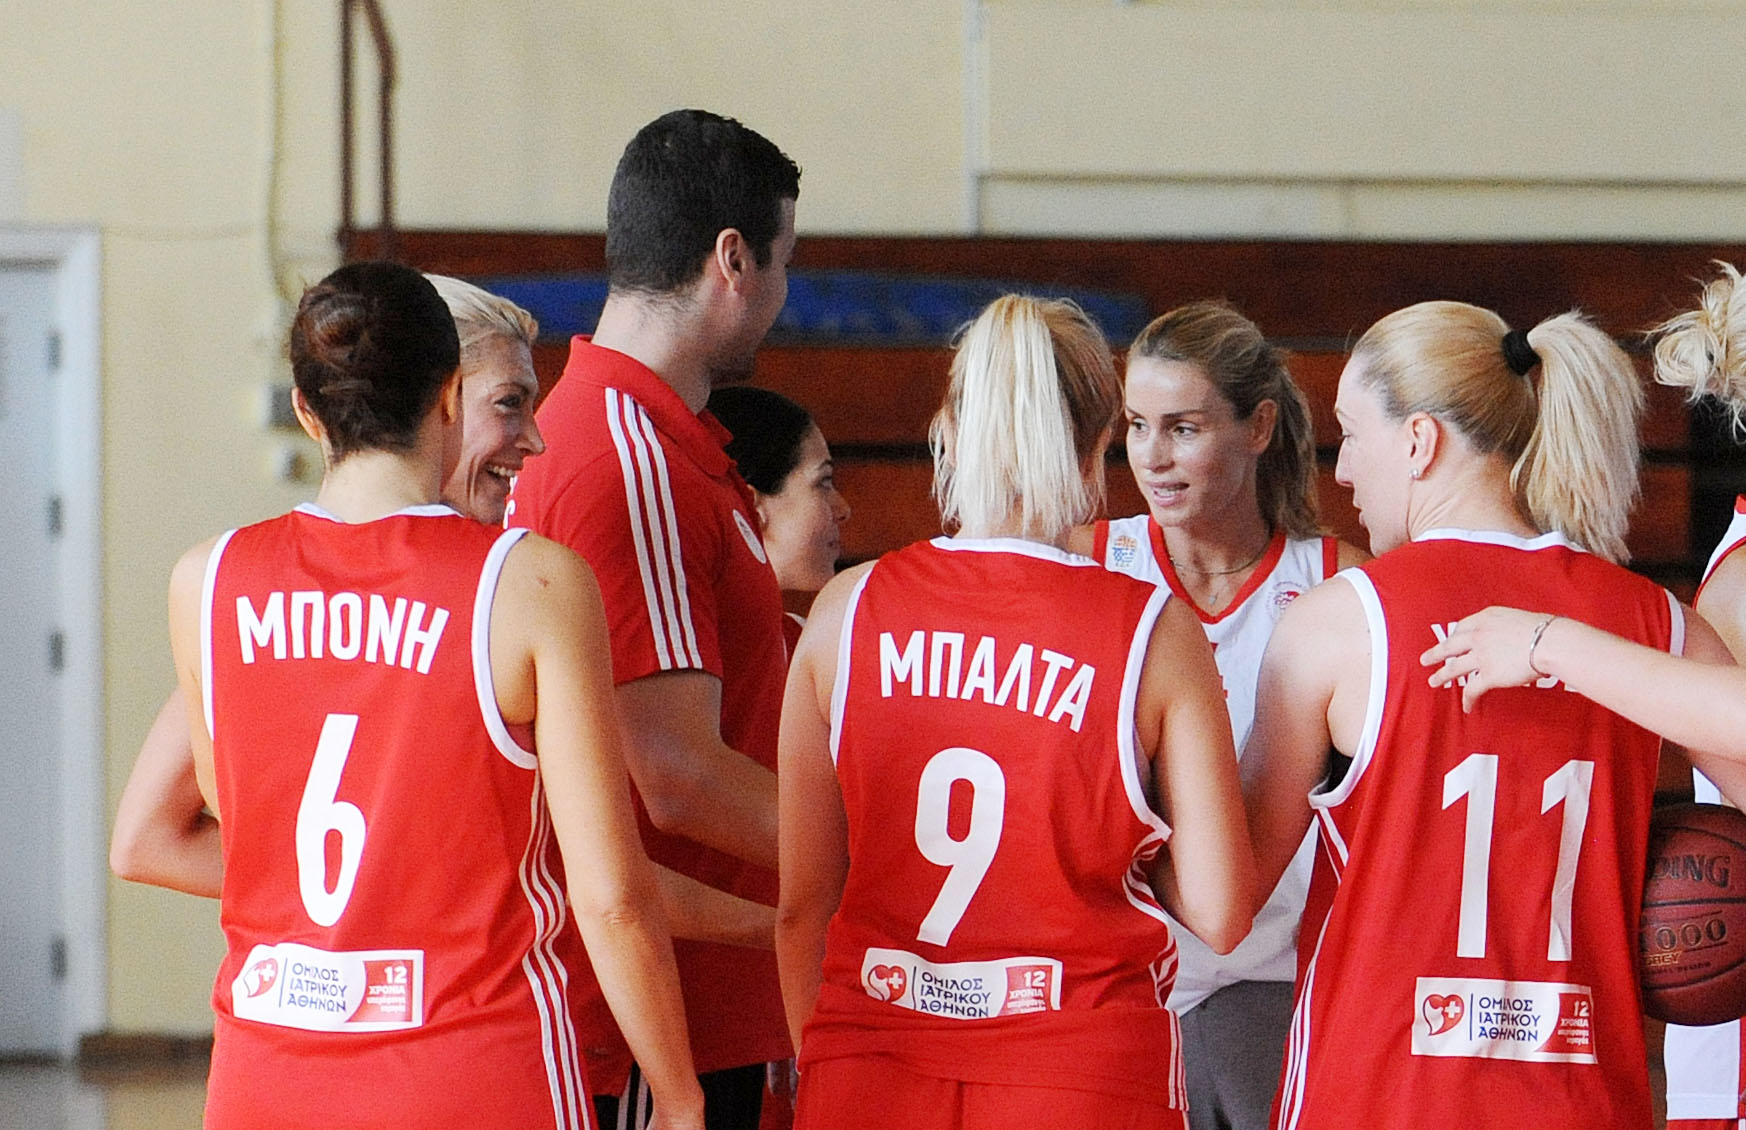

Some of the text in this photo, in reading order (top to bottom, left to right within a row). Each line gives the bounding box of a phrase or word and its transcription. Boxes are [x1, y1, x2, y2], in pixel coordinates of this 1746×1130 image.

[236, 590, 450, 675] ΜΠΟΝΗ
[879, 630, 1096, 734] ΜΠΑΛΤΑ
[295, 713, 368, 927] 6
[915, 747, 1006, 947] 9
[1441, 753, 1595, 962] 11
[383, 965, 408, 983] 12
[921, 971, 983, 991] ΟΜΙΛΟΣ
[1023, 970, 1046, 988] 12
[289, 977, 348, 997] ΙΑΤΡΙΚΟΥ
[920, 984, 991, 1004] ΙΑΤΡΙΚΟΥ
[287, 993, 347, 1012] ΑΘΗΝΩΝ
[920, 999, 989, 1017] ΑΘΗΝΩΝ
[1479, 997, 1533, 1012] ΟΜΙΛΟΣ
[1574, 1001, 1590, 1017] 12
[1479, 1011, 1541, 1026] ΙΑΤΡΙΚΟΥ
[1478, 1026, 1539, 1042] ΑΘΗΝΩΝ
